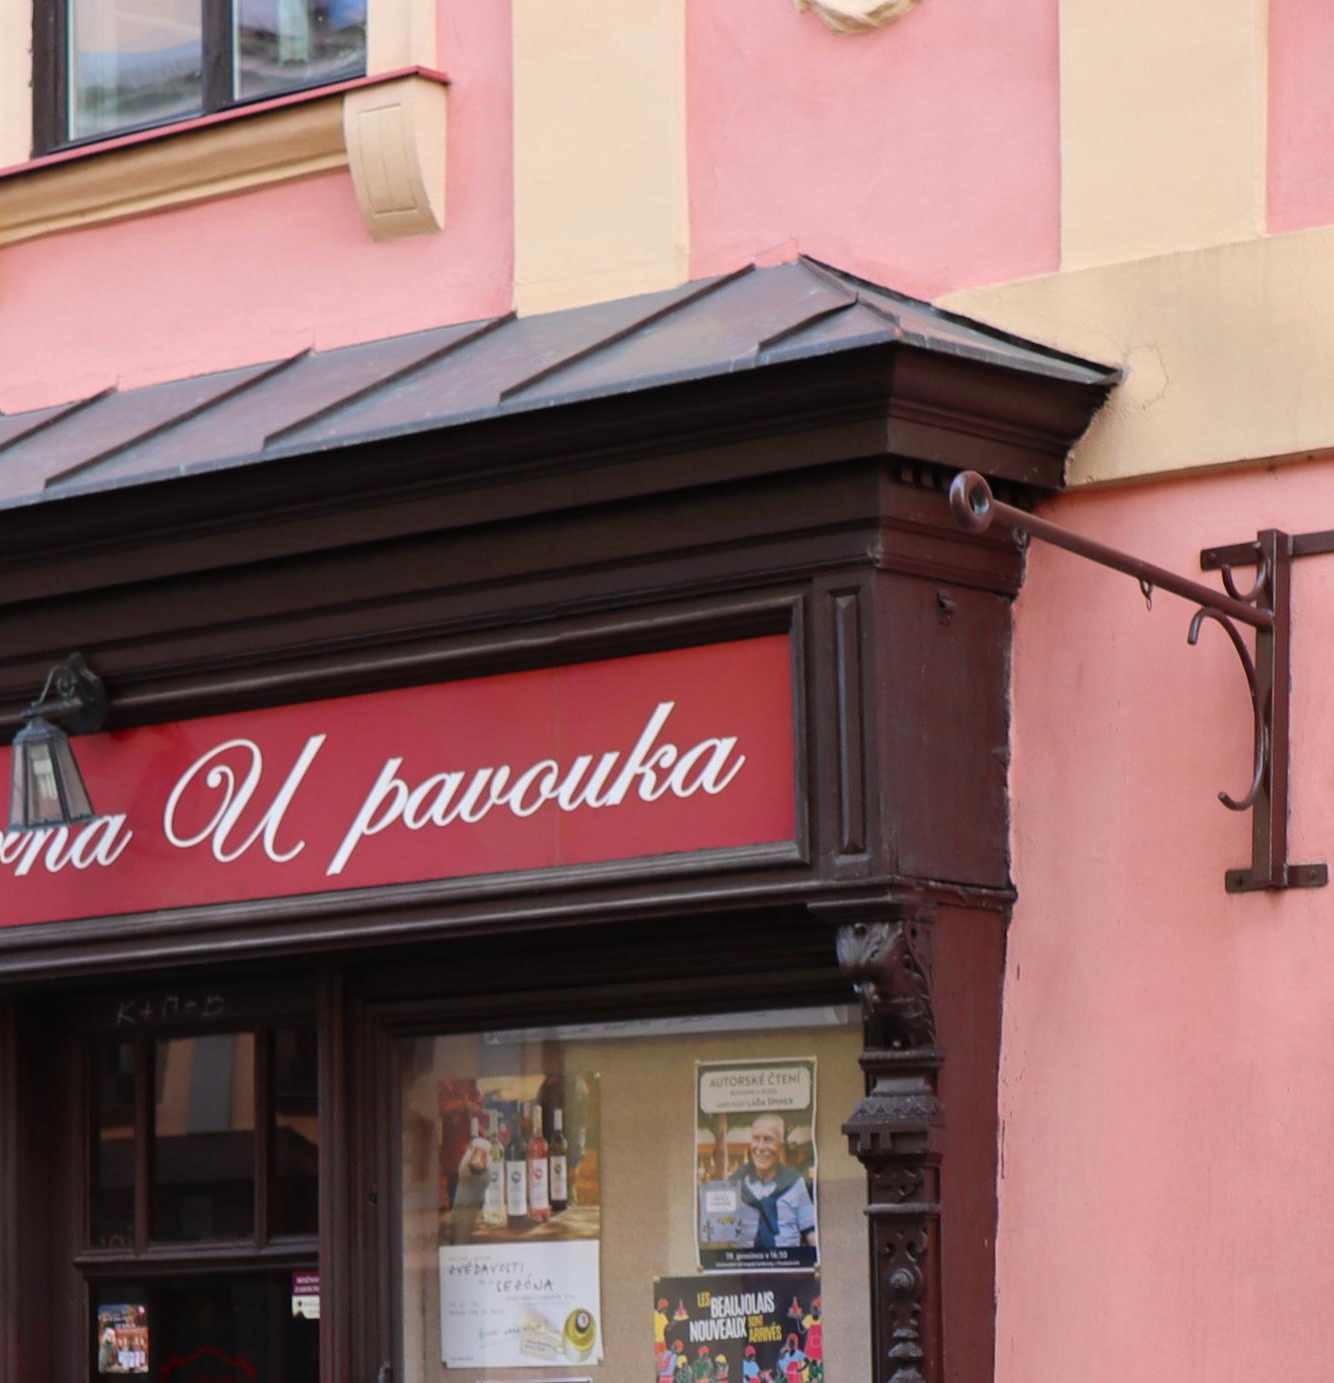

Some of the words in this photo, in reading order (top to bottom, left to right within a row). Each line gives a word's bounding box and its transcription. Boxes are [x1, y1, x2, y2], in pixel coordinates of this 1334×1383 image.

[164, 733, 327, 862] U
[326, 701, 746, 876] pavouka
[709, 1073, 766, 1088] AUTORSKÉ
[767, 1071, 801, 1086] ČTENÍ
[496, 1273, 554, 1292] SEZÓNA
[697, 1291, 711, 1308] LES
[710, 1290, 775, 1318] BEAUJOLAIS
[689, 1316, 747, 1342] NOUVEAUX
[747, 1314, 764, 1327] SONT
[748, 1321, 782, 1343] ARRIVÉS
